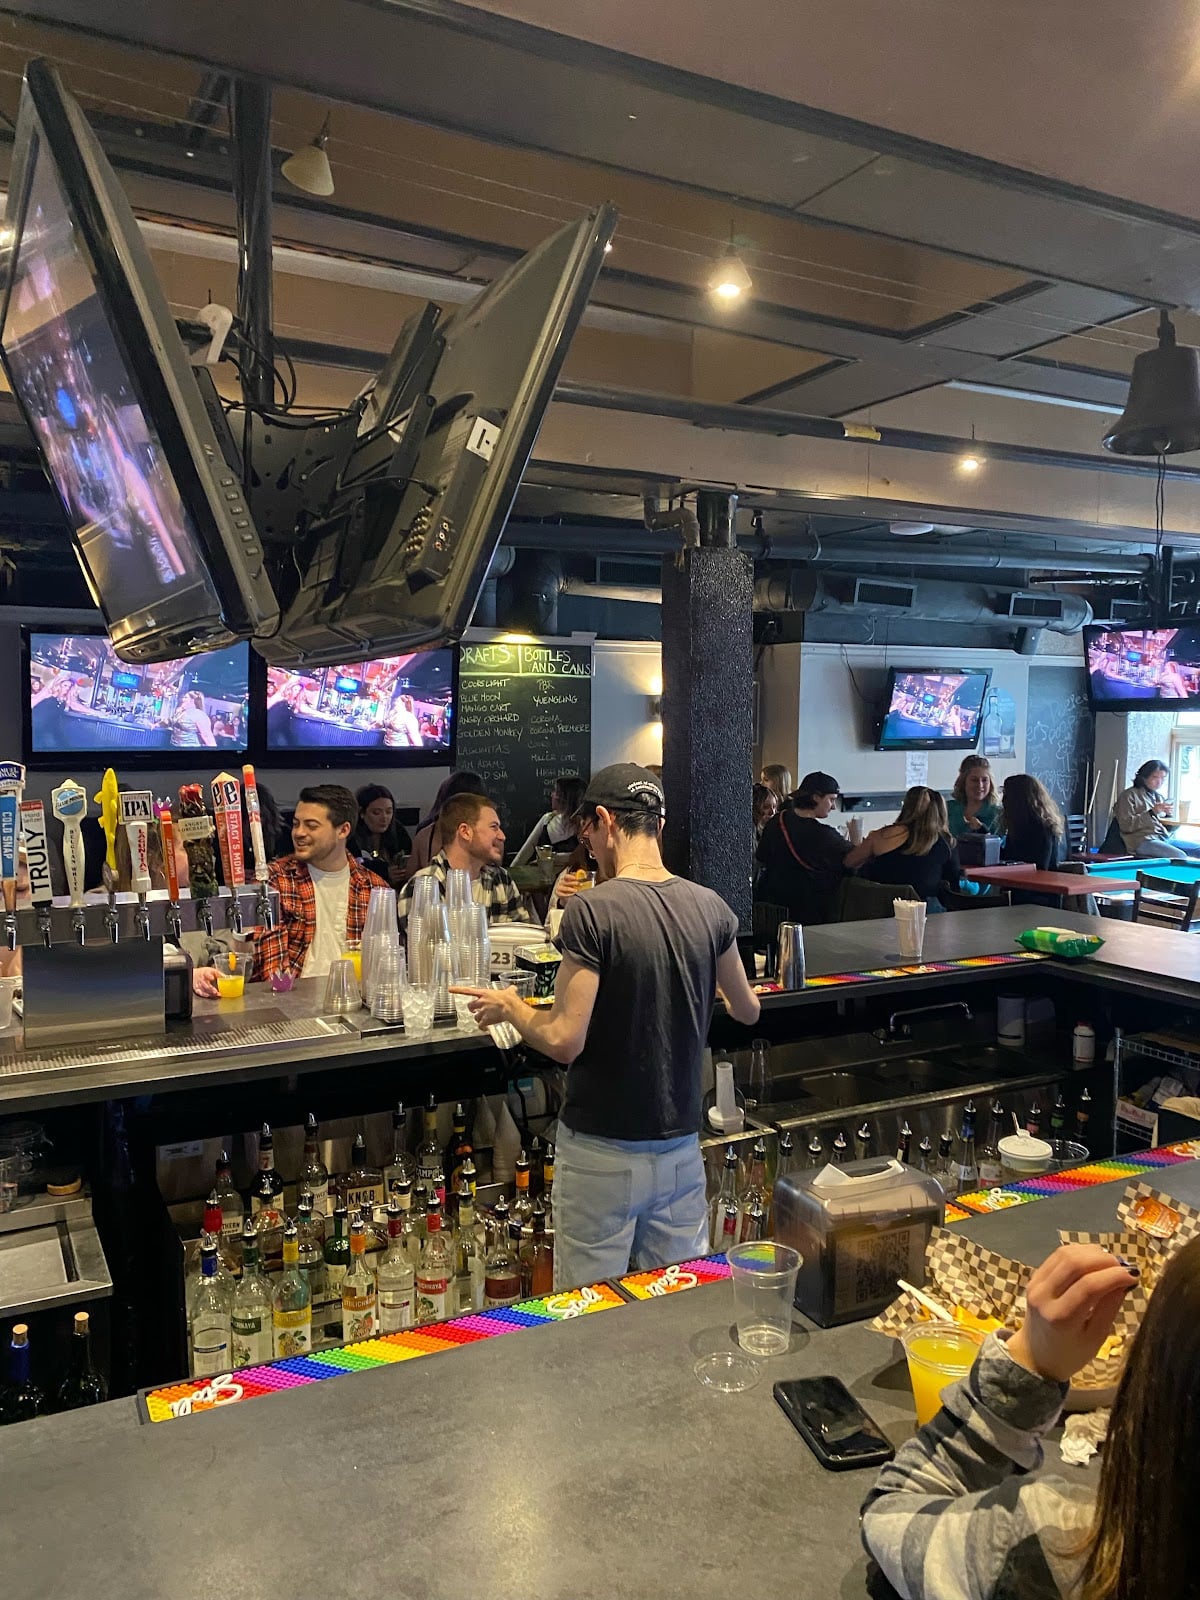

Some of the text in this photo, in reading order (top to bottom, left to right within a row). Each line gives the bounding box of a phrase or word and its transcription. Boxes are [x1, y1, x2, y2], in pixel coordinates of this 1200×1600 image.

[460, 644, 511, 664] DRAFTS
[524, 647, 571, 663] BOTTLES
[531, 661, 591, 675] AND CANS
[461, 680, 485, 689] COORS
[480, 692, 500, 701] MOON
[532, 694, 578, 707] YUENGLING
[461, 704, 487, 712] MANGO
[484, 713, 519, 723] ORCHARD
[124, 800, 149, 816] IPA
[2, 811, 13, 860] COLD SNAP
[229, 813, 241, 850] STACY'S
[25, 828, 50, 894] TRULY
[232, 853, 243, 875] MOM
[491, 952, 511, 964] 23
[547, 1287, 603, 1320] Stoli
